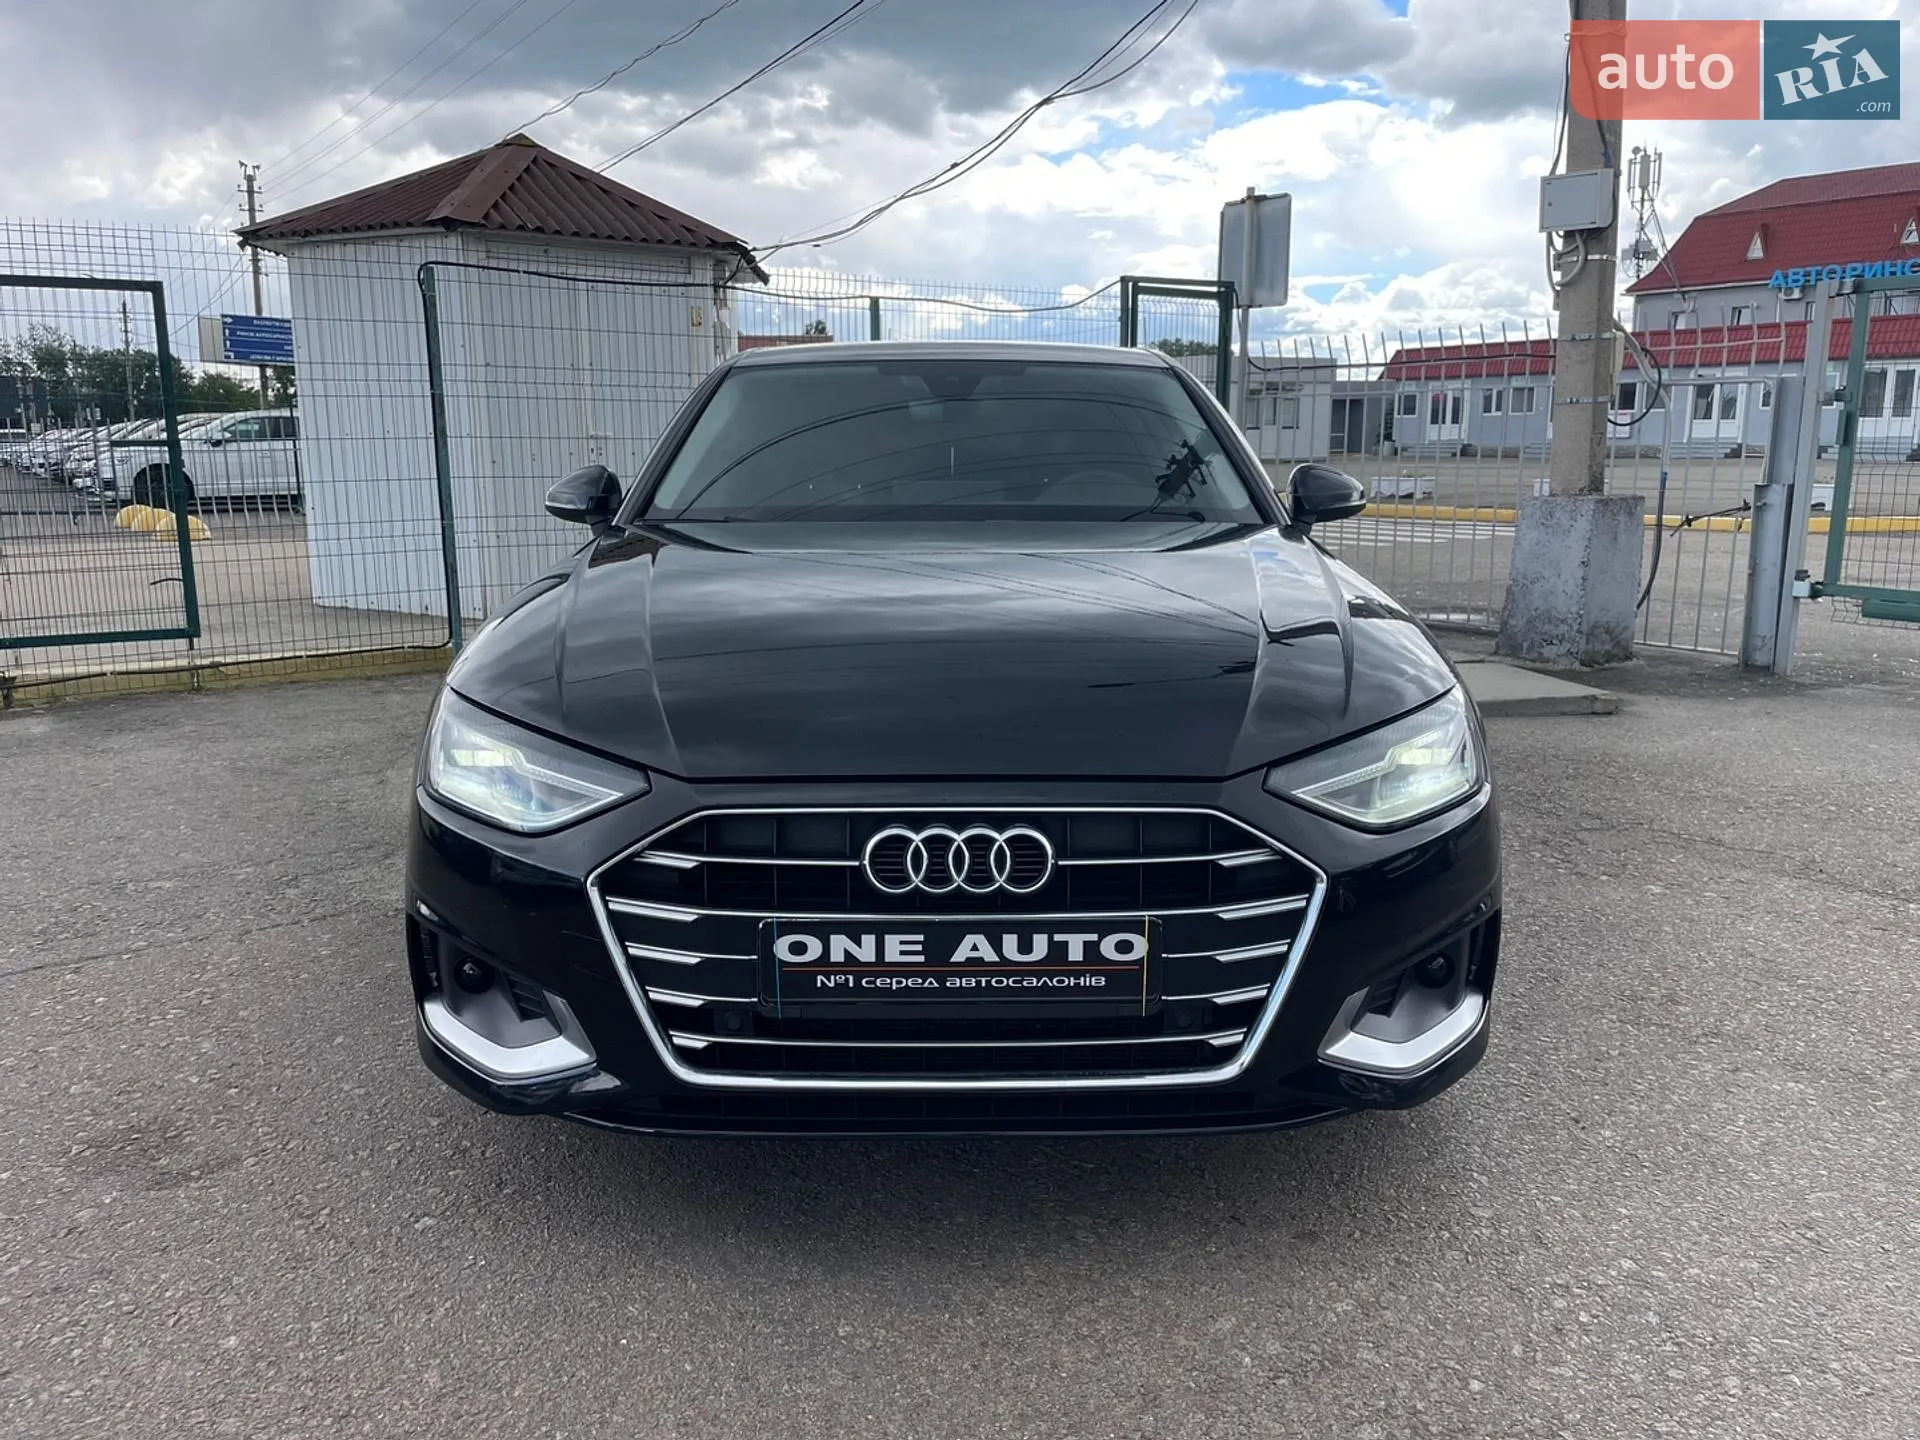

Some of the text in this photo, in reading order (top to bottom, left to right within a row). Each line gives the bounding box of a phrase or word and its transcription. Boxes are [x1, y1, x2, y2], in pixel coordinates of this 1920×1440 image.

[773, 933, 1149, 963] ONE AUTO
[861, 977, 940, 990] серед
[945, 973, 1106, 988] автосалонів
